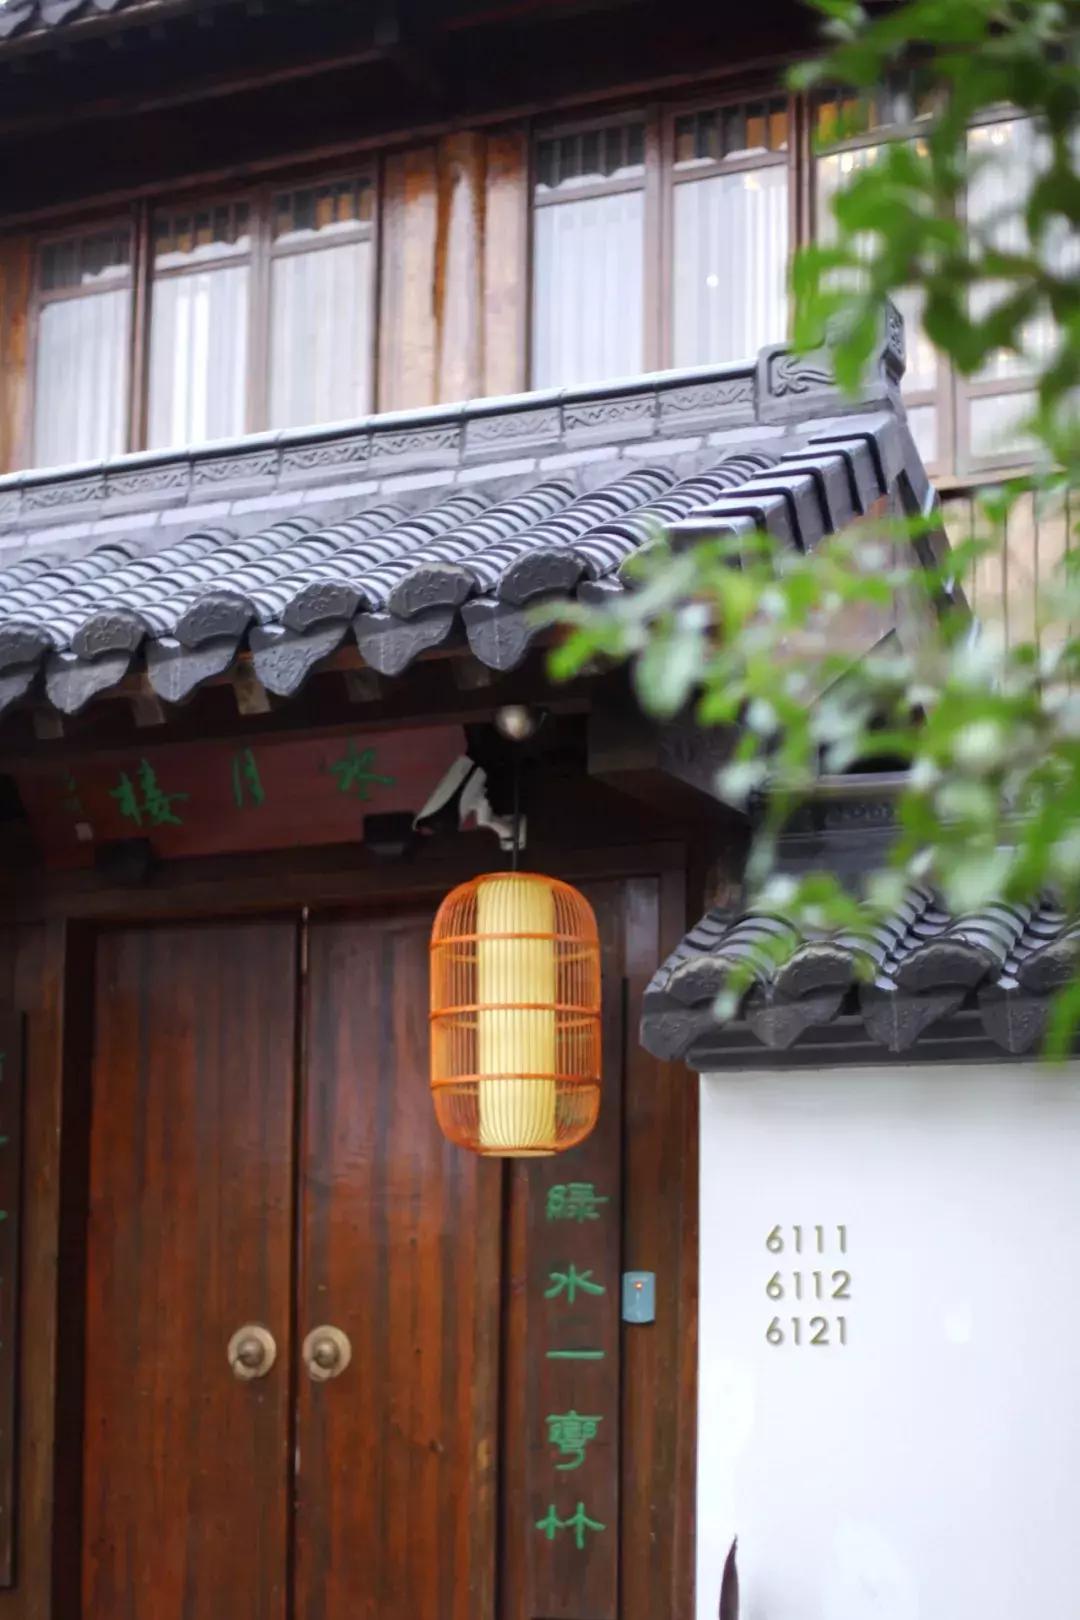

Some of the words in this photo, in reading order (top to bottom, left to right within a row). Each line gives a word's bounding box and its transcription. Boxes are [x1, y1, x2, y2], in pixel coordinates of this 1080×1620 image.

[766, 1224, 847, 1254] 6111
[766, 1270, 851, 1300] 6112
[766, 1316, 847, 1346] 6121
